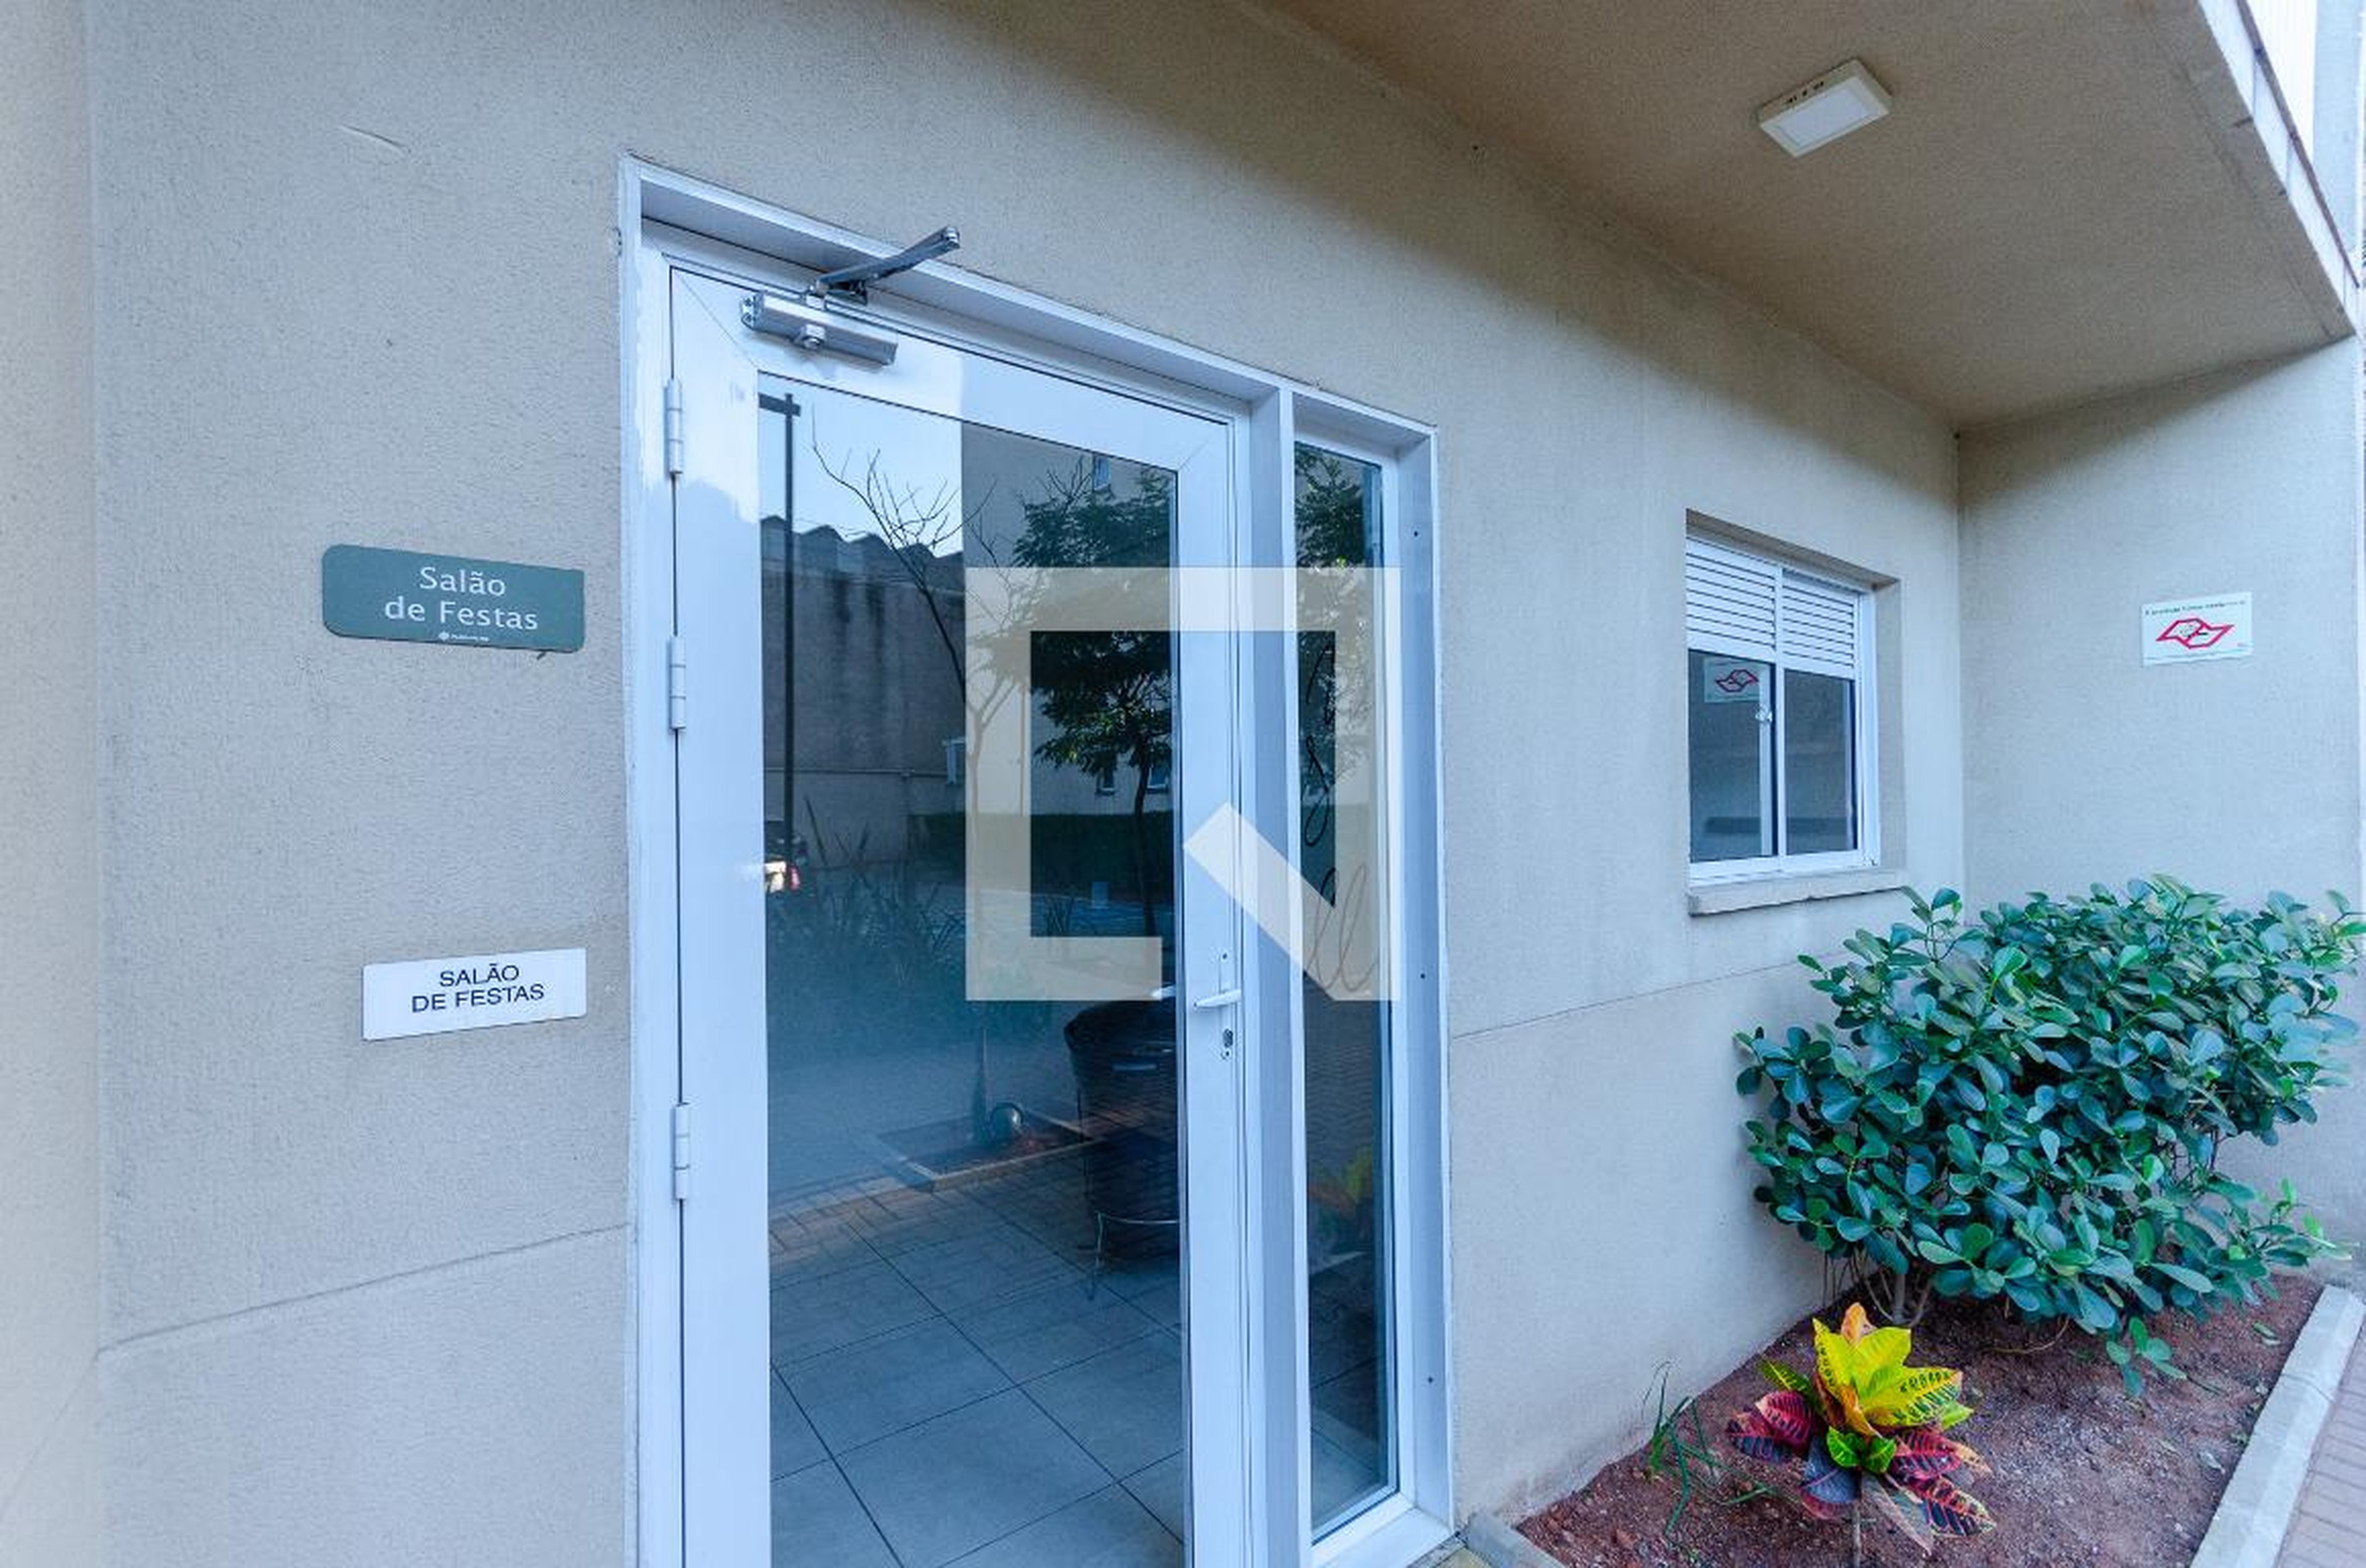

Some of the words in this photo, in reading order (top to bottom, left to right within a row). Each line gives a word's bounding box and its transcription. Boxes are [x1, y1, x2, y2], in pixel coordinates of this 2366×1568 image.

[420, 567, 505, 596] Salão
[384, 596, 426, 622] de
[439, 601, 539, 630] Festas
[439, 964, 519, 987] SALÃO
[412, 993, 447, 1013] DE
[456, 983, 545, 1007] FESTAS
